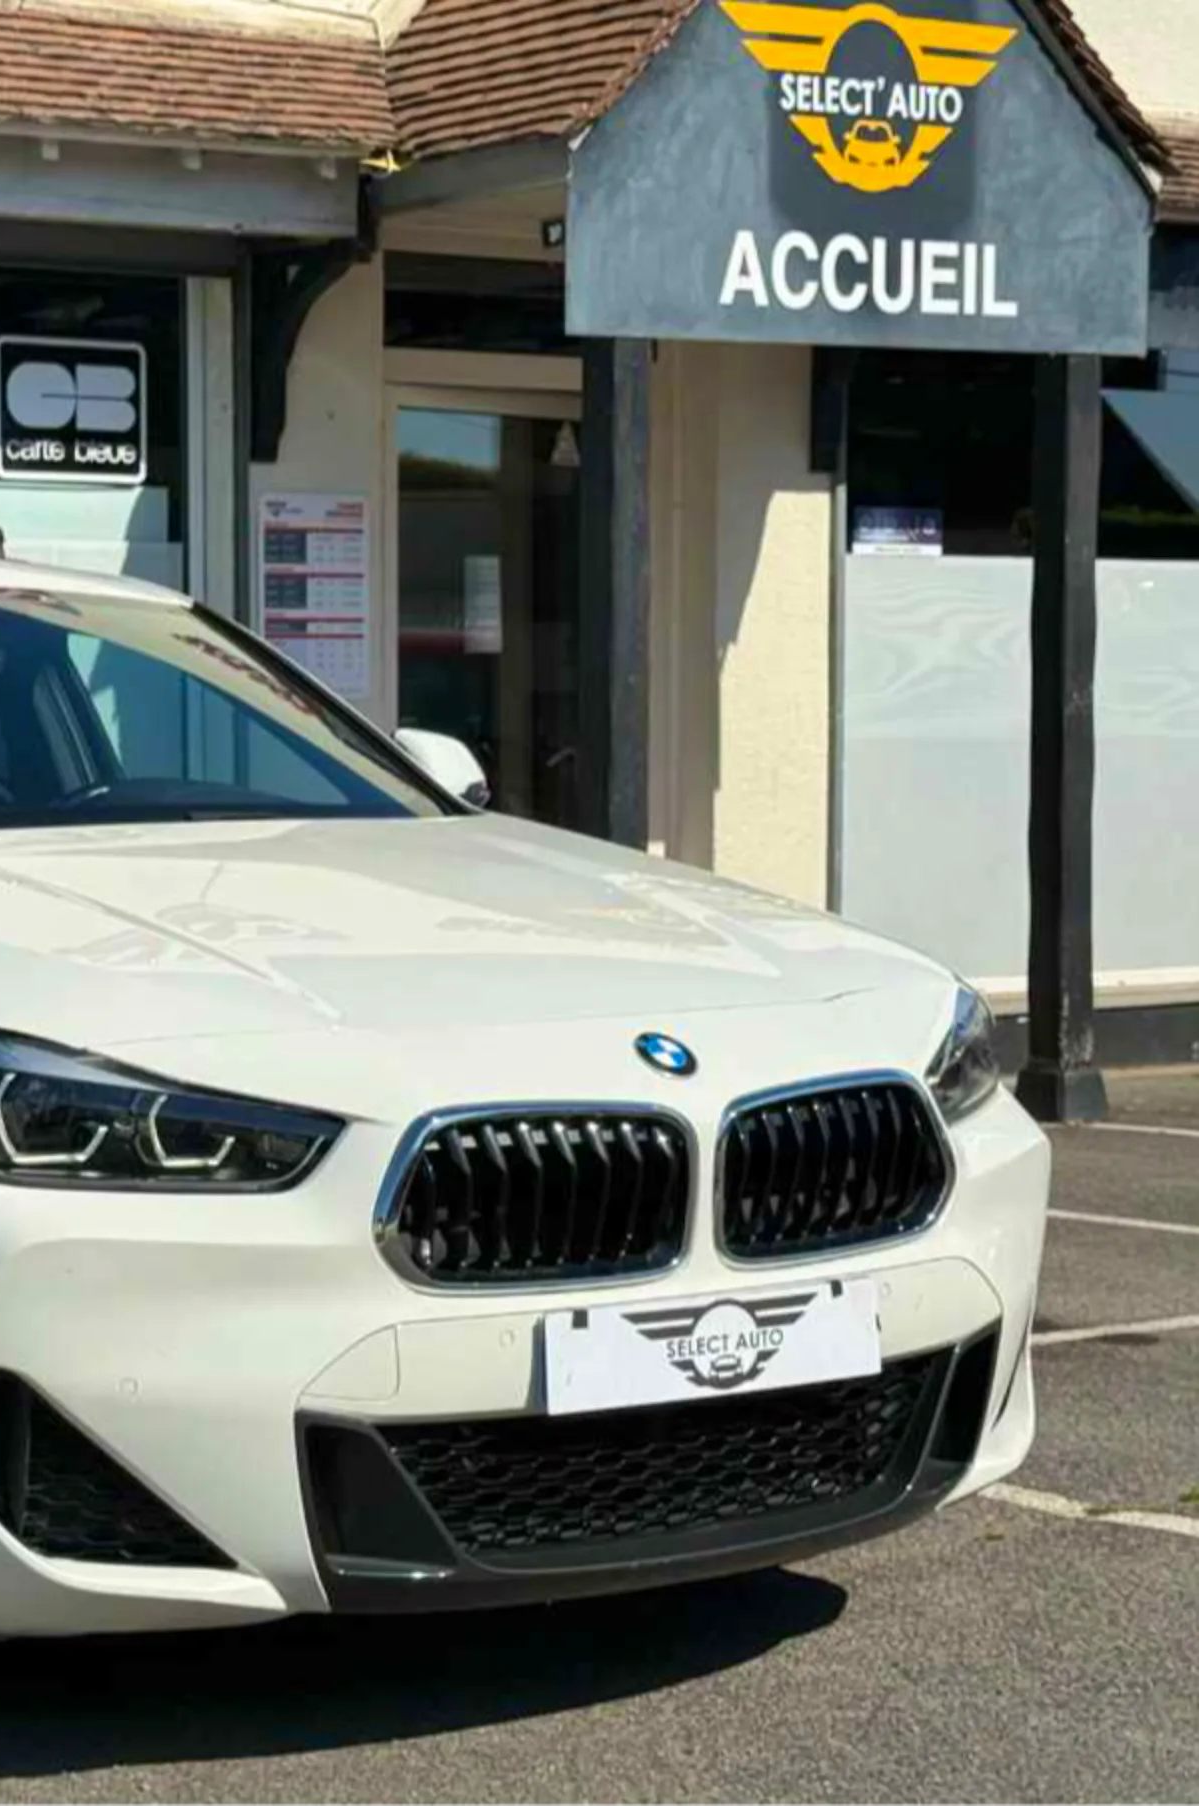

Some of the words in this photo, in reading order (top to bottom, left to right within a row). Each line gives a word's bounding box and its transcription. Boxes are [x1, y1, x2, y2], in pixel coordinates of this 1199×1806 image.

[886, 82, 963, 123] AUTO
[719, 230, 1018, 317] ACCUEIL
[6, 438, 66, 461] carte
[666, 1333, 729, 1359] SELECT
[735, 1328, 784, 1350] AUTO
